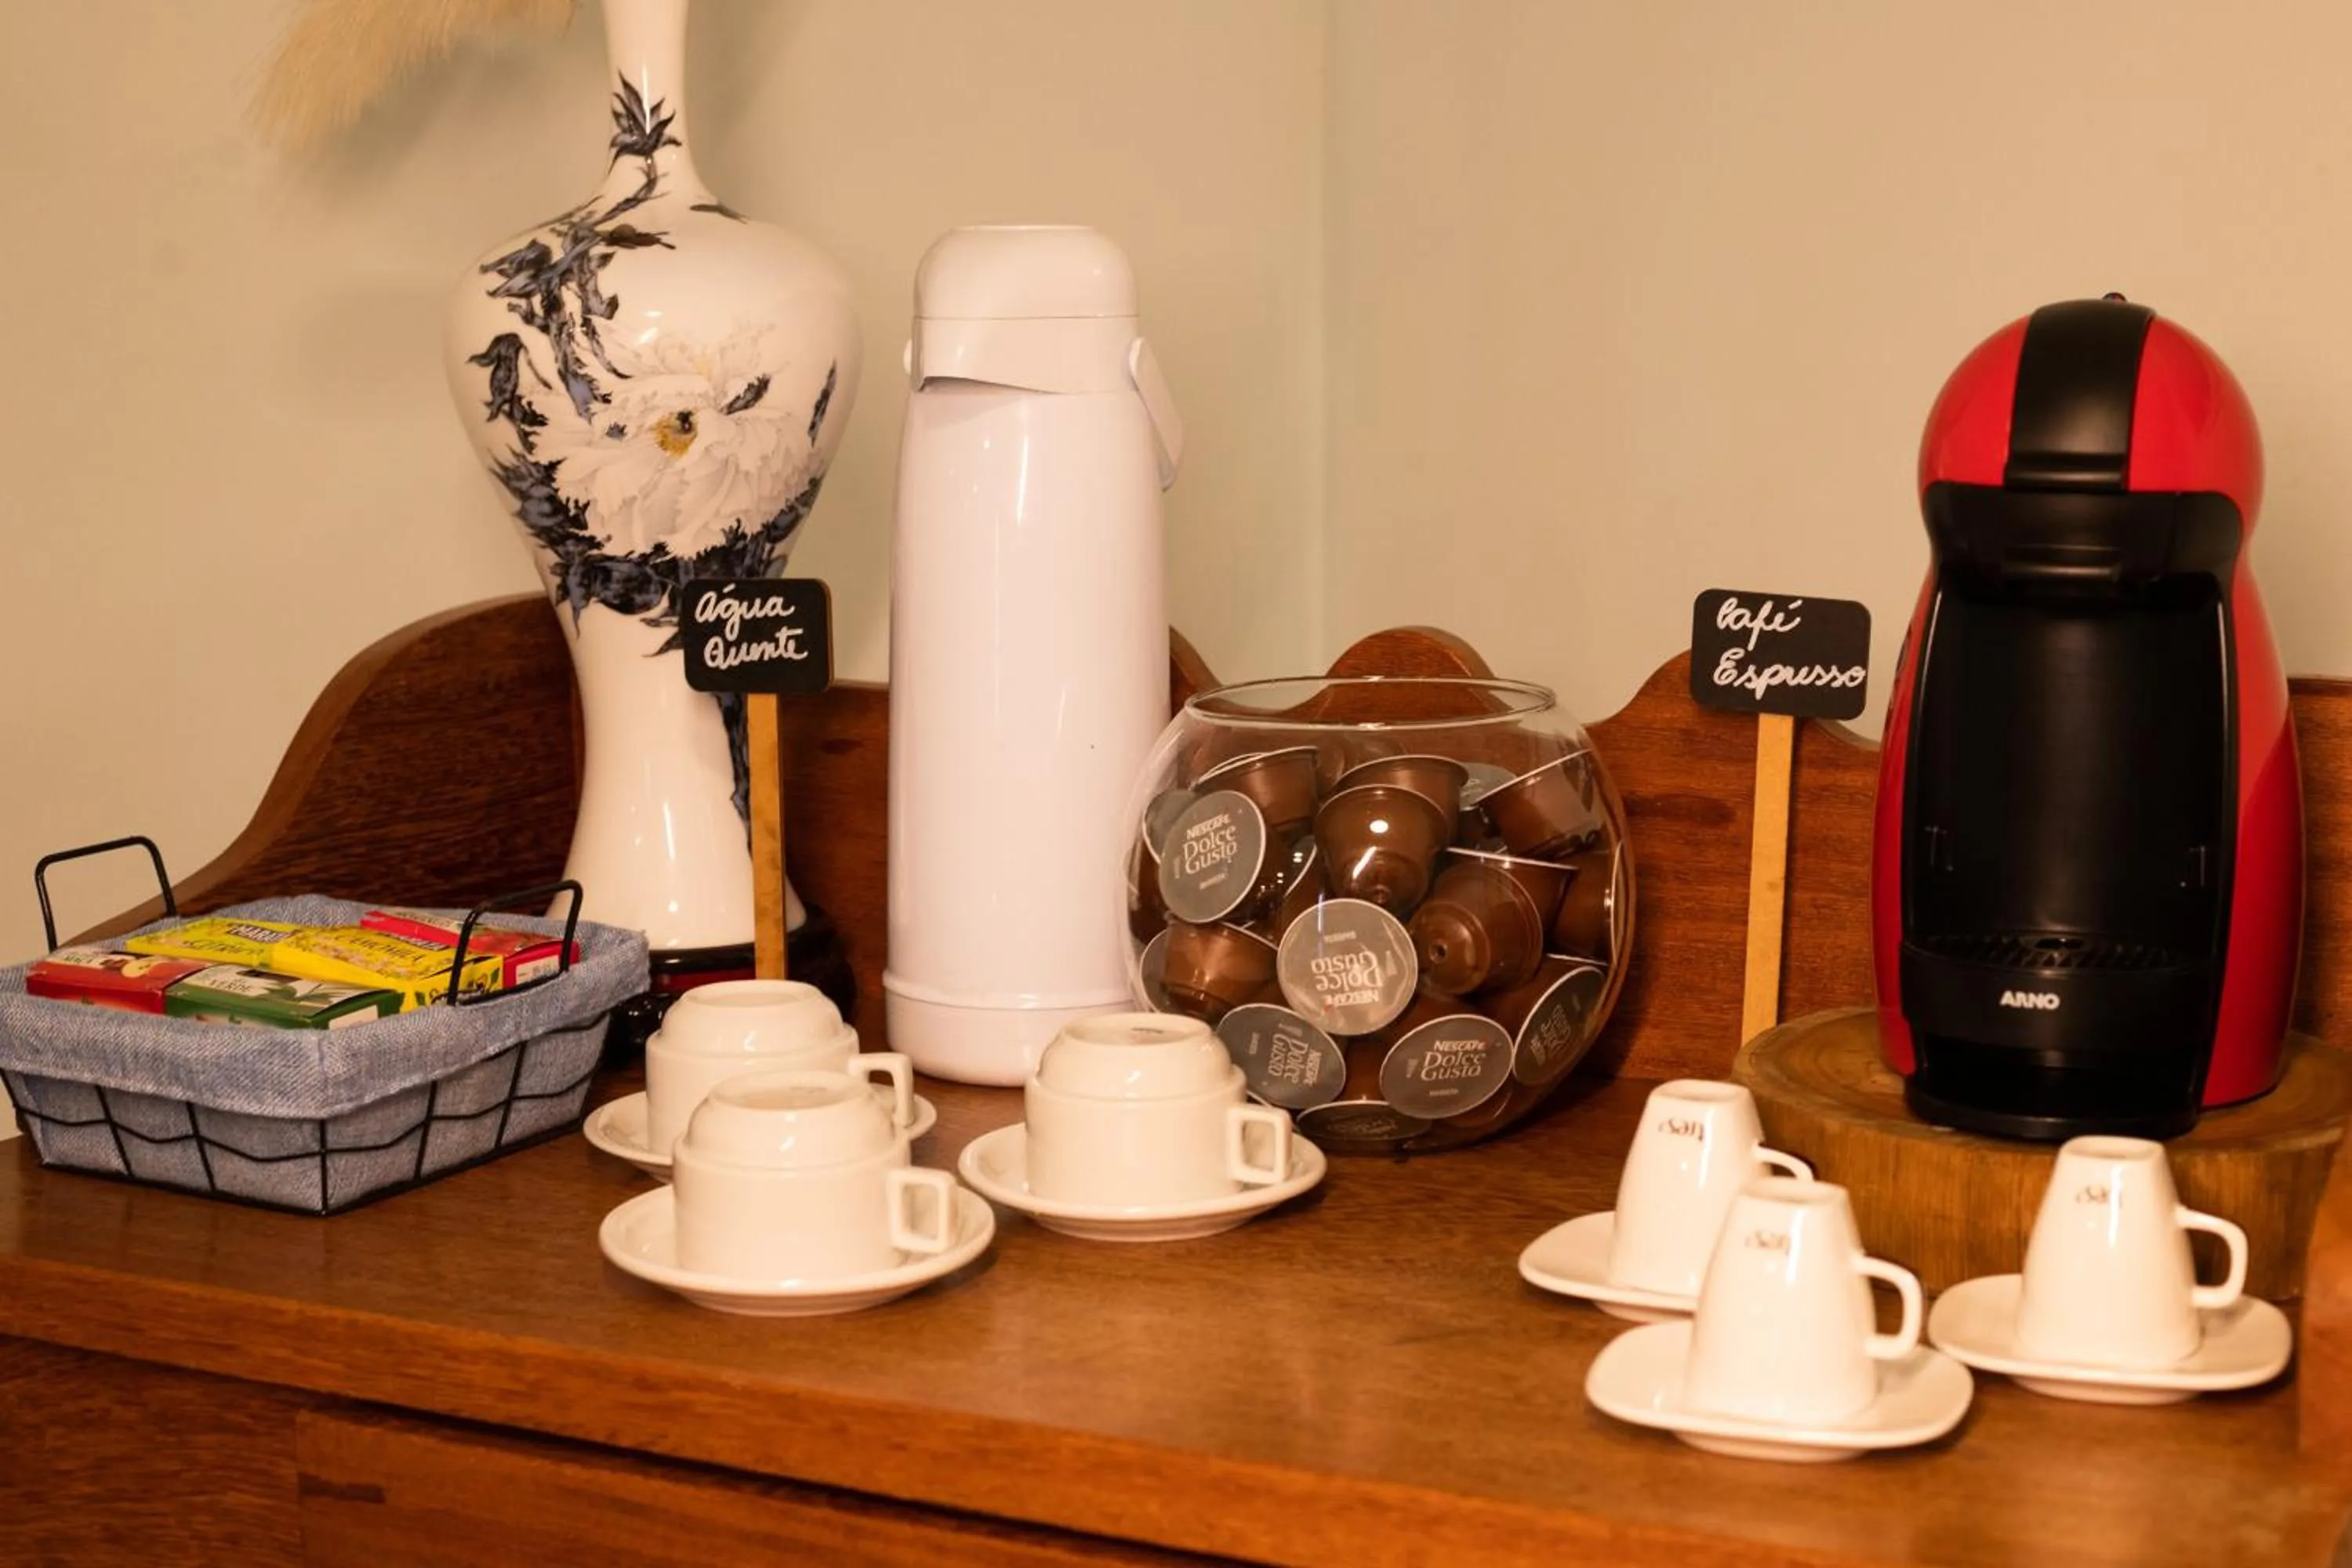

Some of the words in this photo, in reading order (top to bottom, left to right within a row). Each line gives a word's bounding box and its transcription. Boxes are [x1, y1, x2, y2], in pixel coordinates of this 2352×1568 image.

[695, 583, 795, 641] Água
[1716, 597, 1802, 652] Café
[1713, 647, 1866, 700] Espresso
[1183, 826, 1236, 860] Dolce
[1185, 840, 1237, 874] Gusto
[1311, 950, 1378, 975] Gusto
[1314, 967, 1383, 992] Dolce
[2001, 990, 2060, 1010] ARNO
[1421, 1065, 1481, 1081] Gusto
[1423, 1051, 1486, 1067] Dolce
